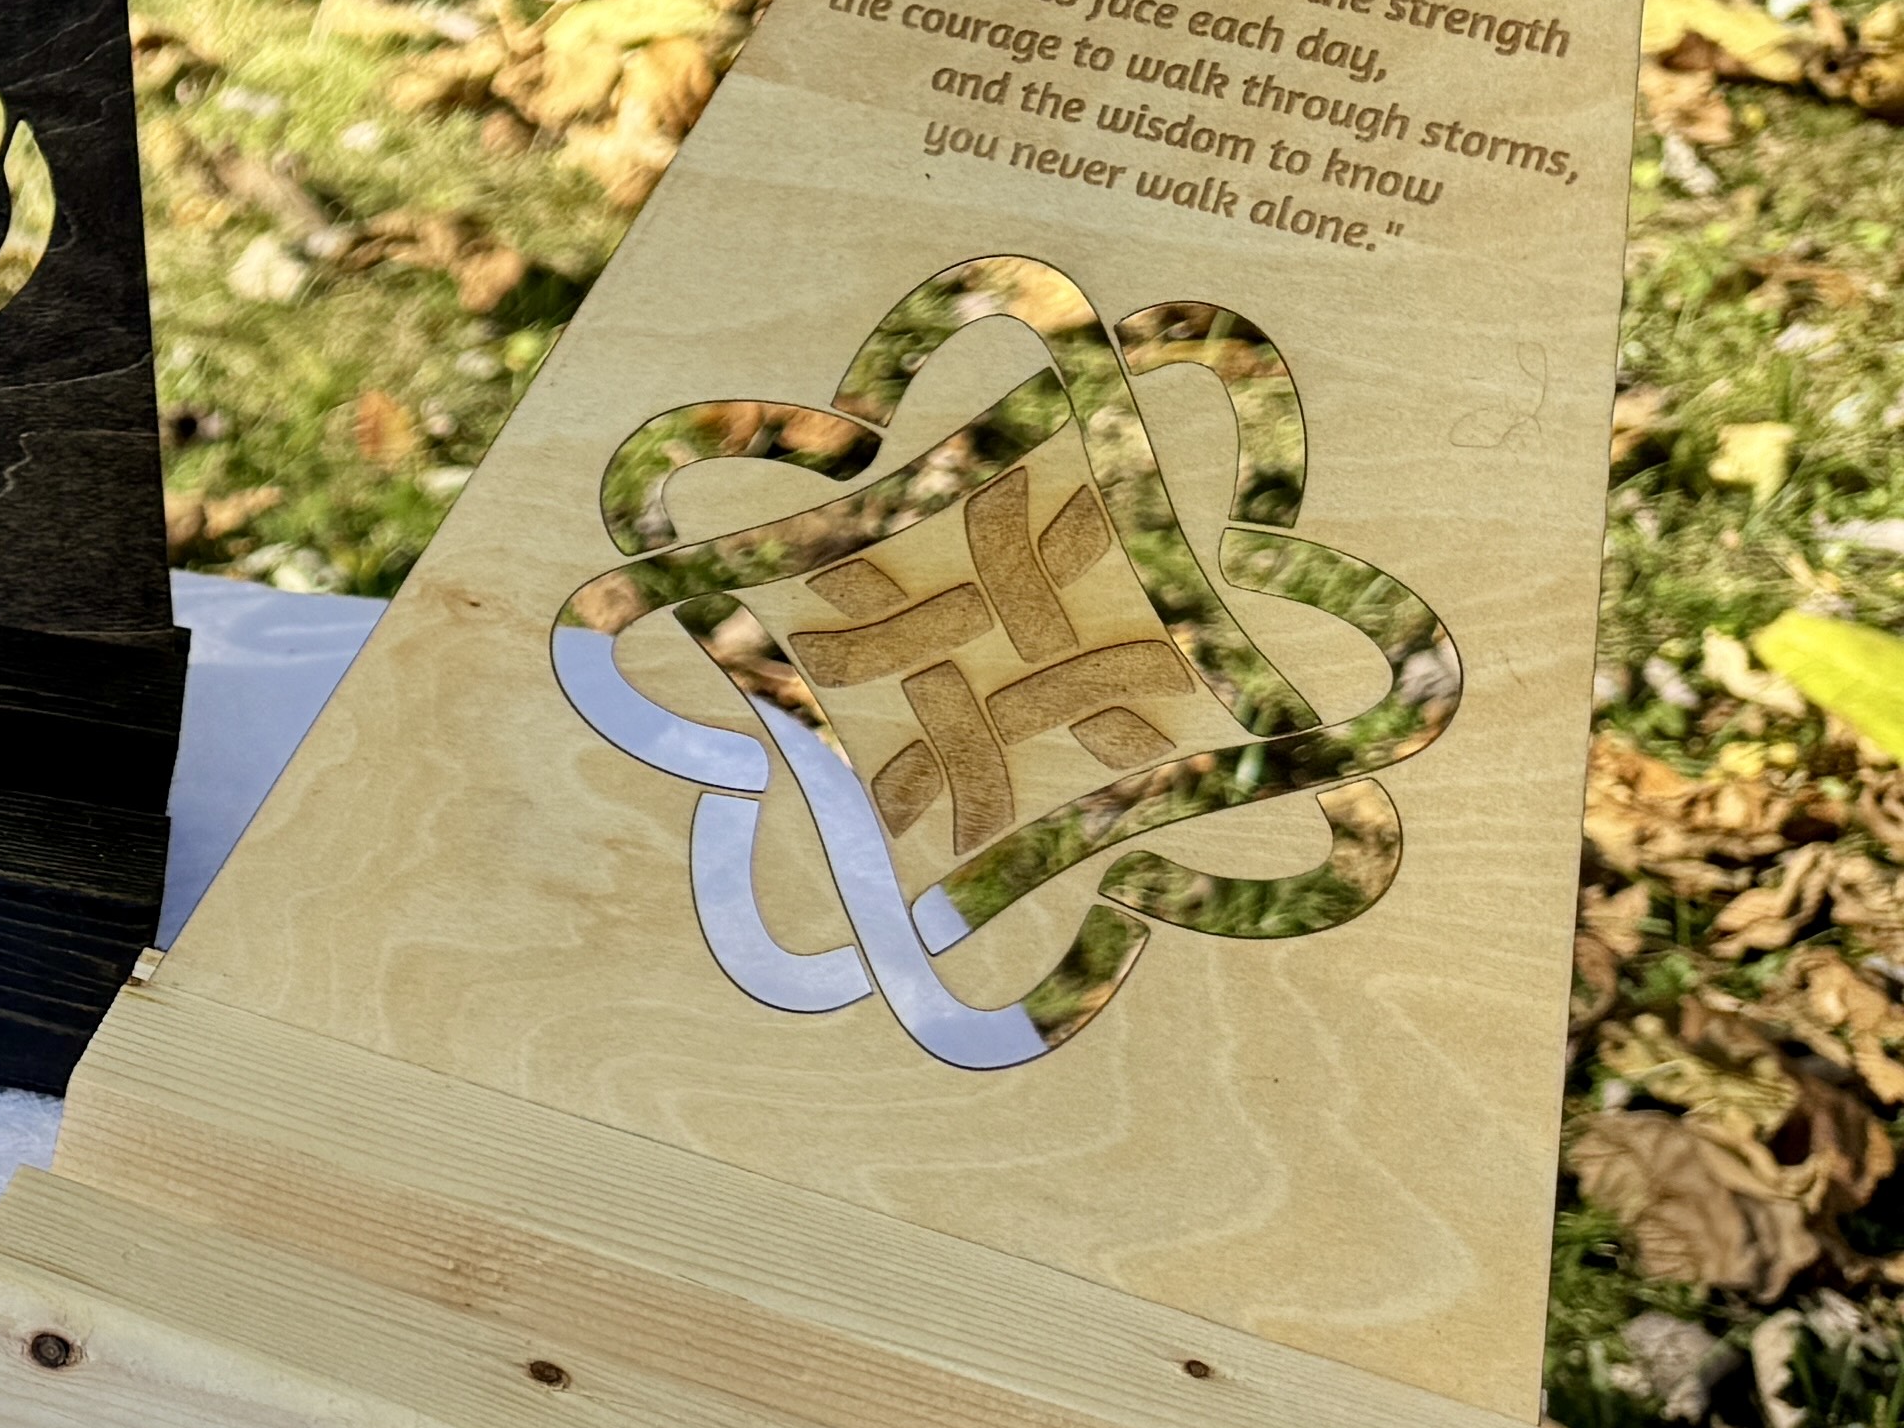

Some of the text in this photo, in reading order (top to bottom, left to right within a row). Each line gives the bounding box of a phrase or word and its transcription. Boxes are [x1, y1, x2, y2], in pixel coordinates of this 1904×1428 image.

[902, 3, 1061, 63] courage
[1074, 34, 1114, 71] to
[1126, 54, 1229, 99] walk
[1242, 75, 1410, 143] through
[1420, 121, 1578, 185] storms,
[1188, 11, 1284, 53] each
[1296, 27, 1386, 82] day,
[924, 122, 1404, 251] you never walk alone."
[932, 68, 1443, 205] and the wisdom to know
